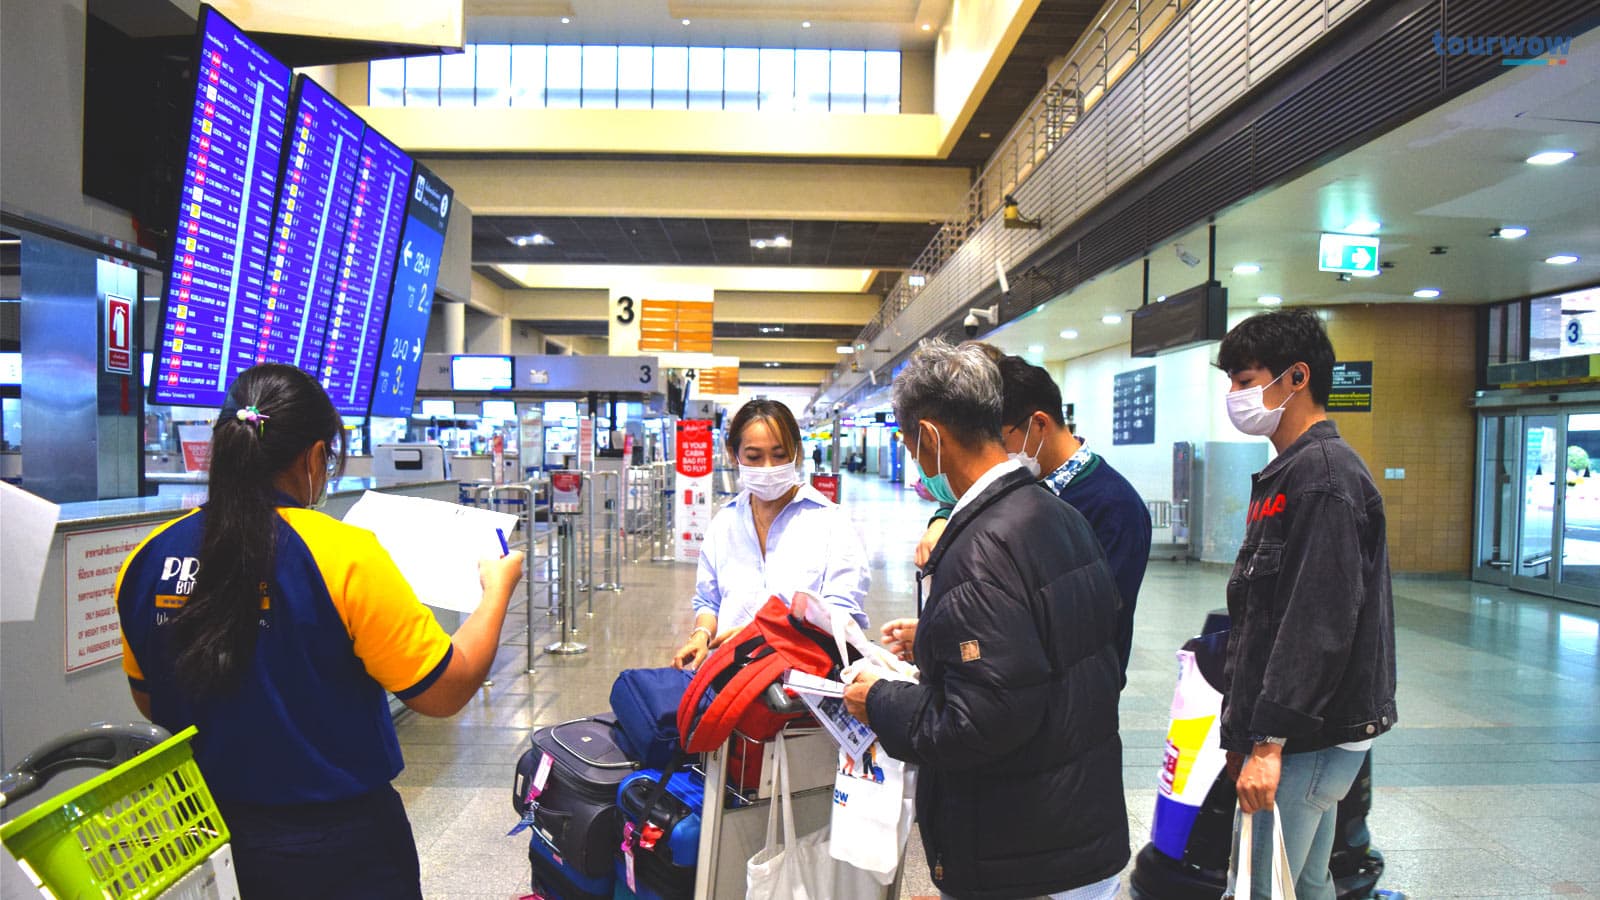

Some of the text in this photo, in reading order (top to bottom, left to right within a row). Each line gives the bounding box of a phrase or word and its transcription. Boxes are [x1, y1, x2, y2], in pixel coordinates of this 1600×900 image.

[616, 296, 635, 324] 3
[1567, 322, 1579, 344] 3
[392, 364, 402, 395] 3
[639, 365, 652, 384] 3
[685, 368, 696, 381] 4
[701, 404, 709, 414] 4
[689, 441, 708, 449] YOUR
[684, 449, 705, 457] CABIN
[682, 457, 707, 465] BAG FIT
[692, 465, 707, 473] FLY?
